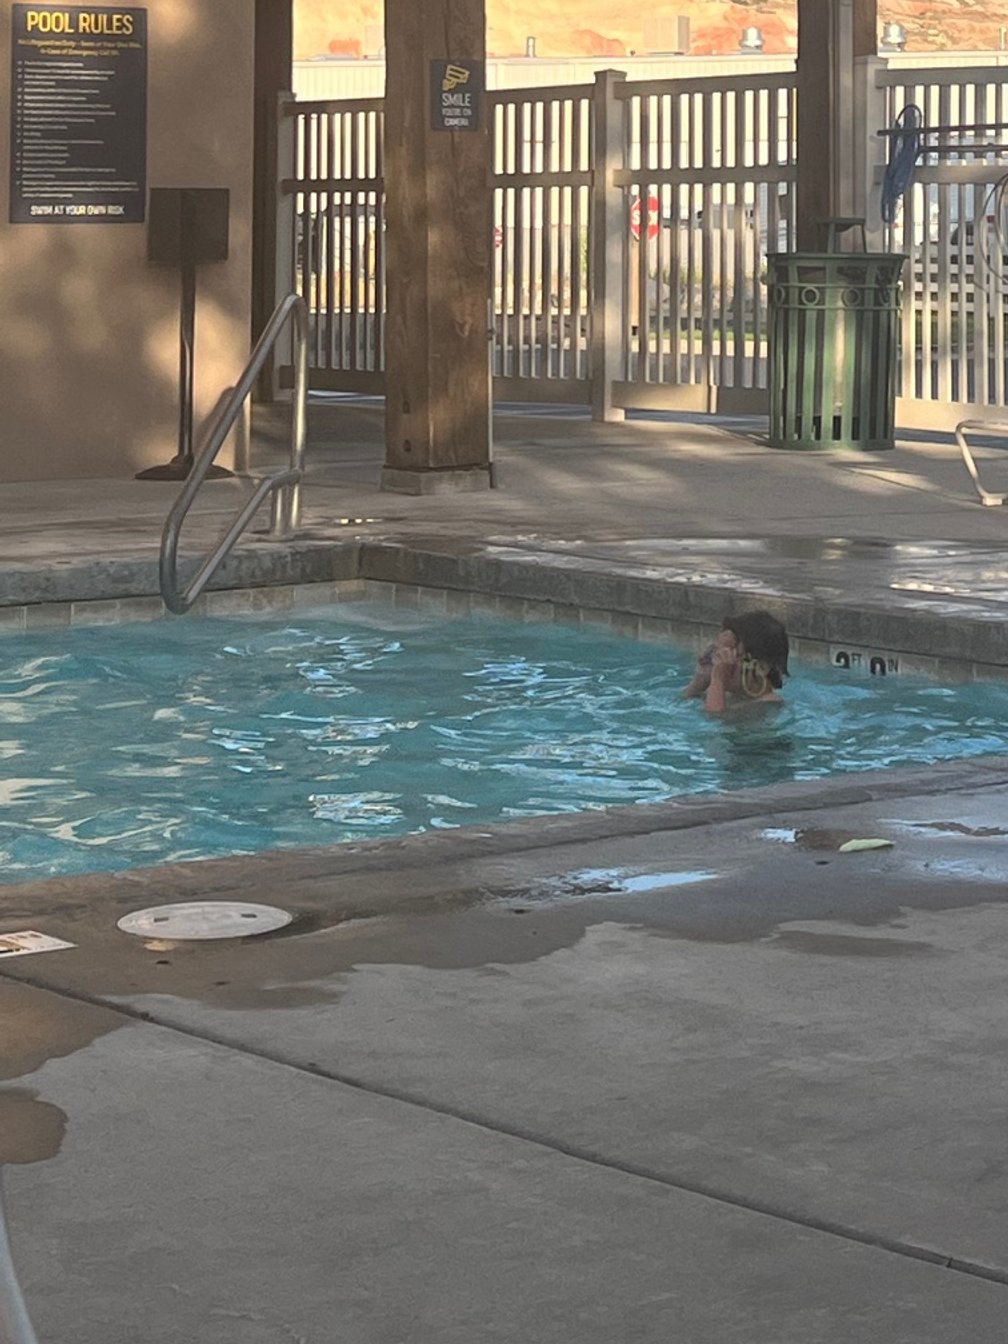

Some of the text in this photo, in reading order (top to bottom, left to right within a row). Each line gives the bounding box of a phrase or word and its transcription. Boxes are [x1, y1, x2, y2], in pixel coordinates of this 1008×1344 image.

[27, 10, 133, 35] POOL RULES
[442, 93, 471, 107] SMILE
[30, 205, 53, 216] SWIM
[53, 205, 64, 215] AT
[65, 205, 86, 216] YOUR
[87, 205, 106, 216] OWN
